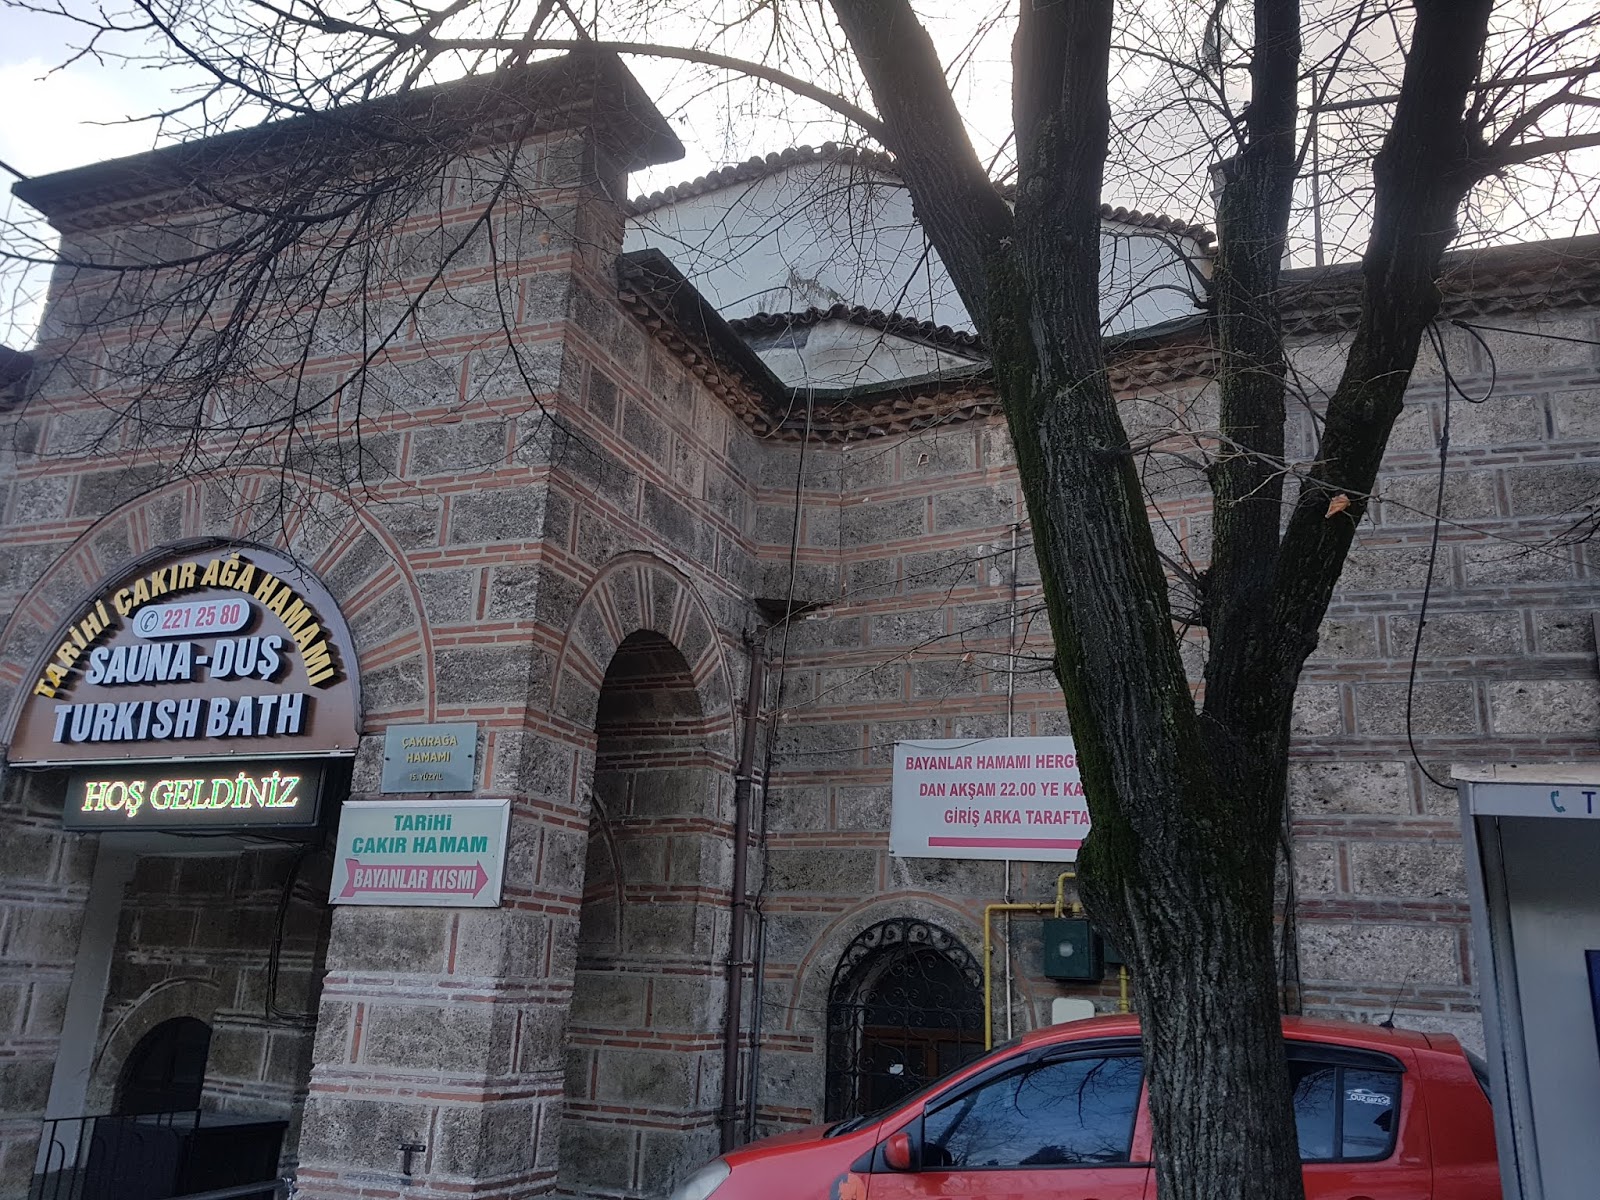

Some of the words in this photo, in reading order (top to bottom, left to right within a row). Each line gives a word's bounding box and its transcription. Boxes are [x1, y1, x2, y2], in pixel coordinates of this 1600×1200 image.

[113, 560, 196, 617] ÇAKIR
[201, 553, 256, 592] AĞA
[253, 573, 335, 686] HAMAMI
[162, 609, 190, 630] 221
[197, 607, 216, 627] 25
[219, 604, 240, 625] 80
[52, 699, 200, 743] TURKISH
[206, 693, 303, 738] BATH
[407, 751, 451, 763] HAMAMI
[906, 756, 972, 770] BAYANLAR
[976, 755, 1031, 769] HAMAMI
[1036, 754, 1078, 769] HERG
[82, 780, 144, 817] HOŞ
[150, 771, 301, 809] GELDİNİZ
[919, 783, 946, 797] DAN
[950, 783, 996, 800] AKŞAM
[1000, 782, 1036, 797] 22.00
[1040, 782, 1059, 797] YE
[944, 807, 980, 827] GİRİŞ
[984, 810, 1021, 824] ARKA
[413, 836, 488, 853] HAMAM
[353, 868, 428, 888] BAYANLAR
[432, 869, 477, 889] KISMI
